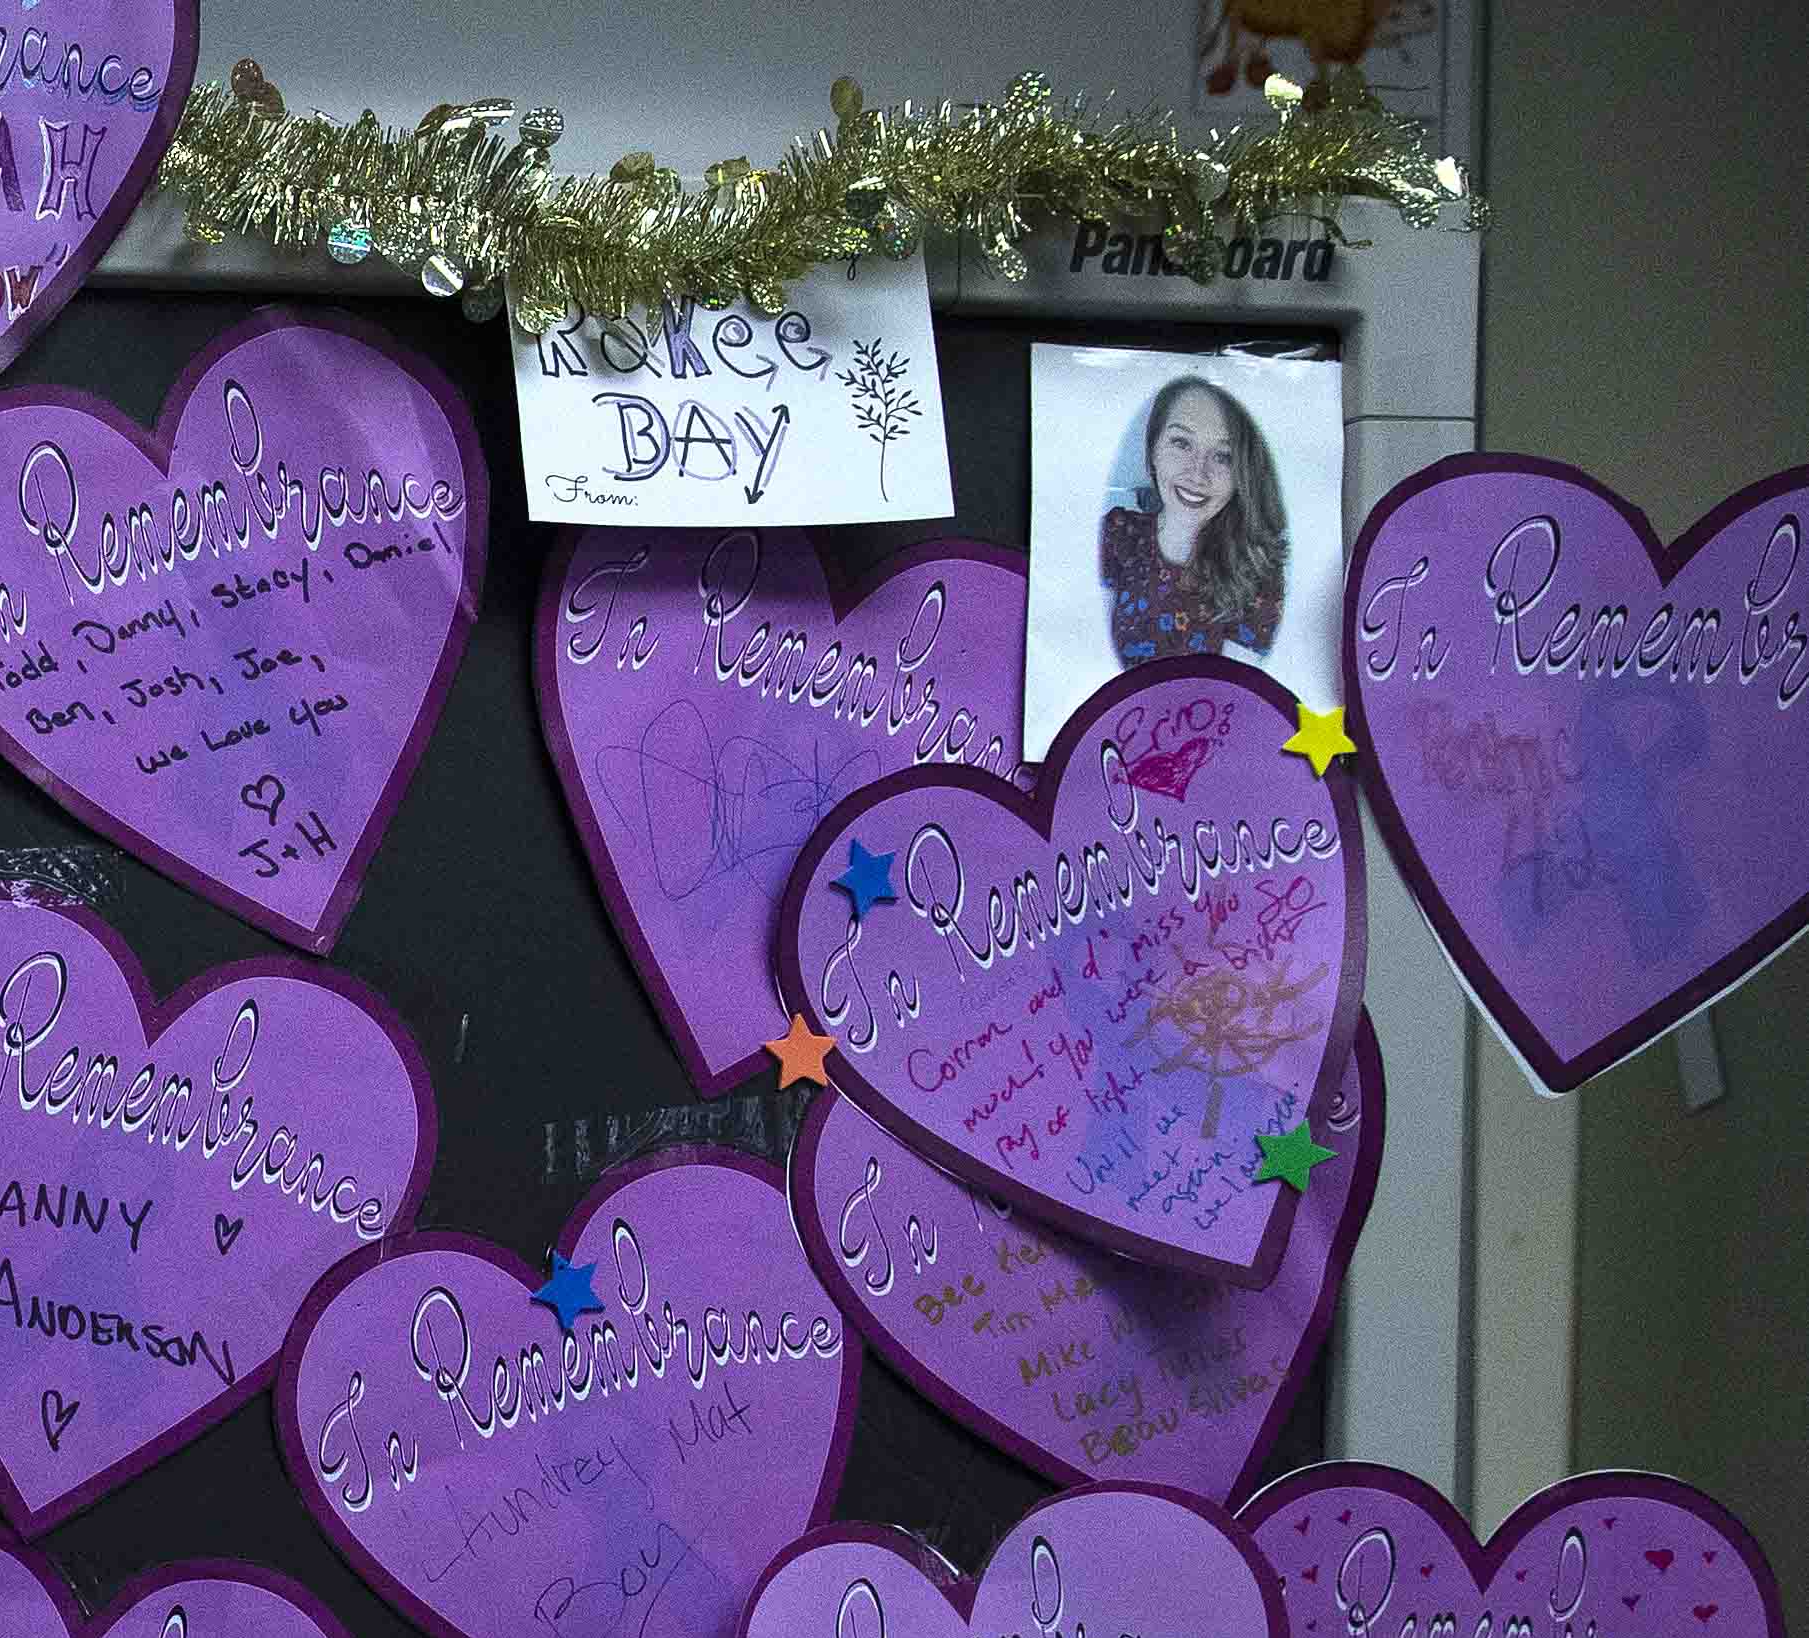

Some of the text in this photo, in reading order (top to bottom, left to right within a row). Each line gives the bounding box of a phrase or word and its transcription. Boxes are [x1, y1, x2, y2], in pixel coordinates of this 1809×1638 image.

[19, 377, 465, 607] Remembrance
[545, 474, 639, 506] From:
[318, 1371, 418, 1512] In
